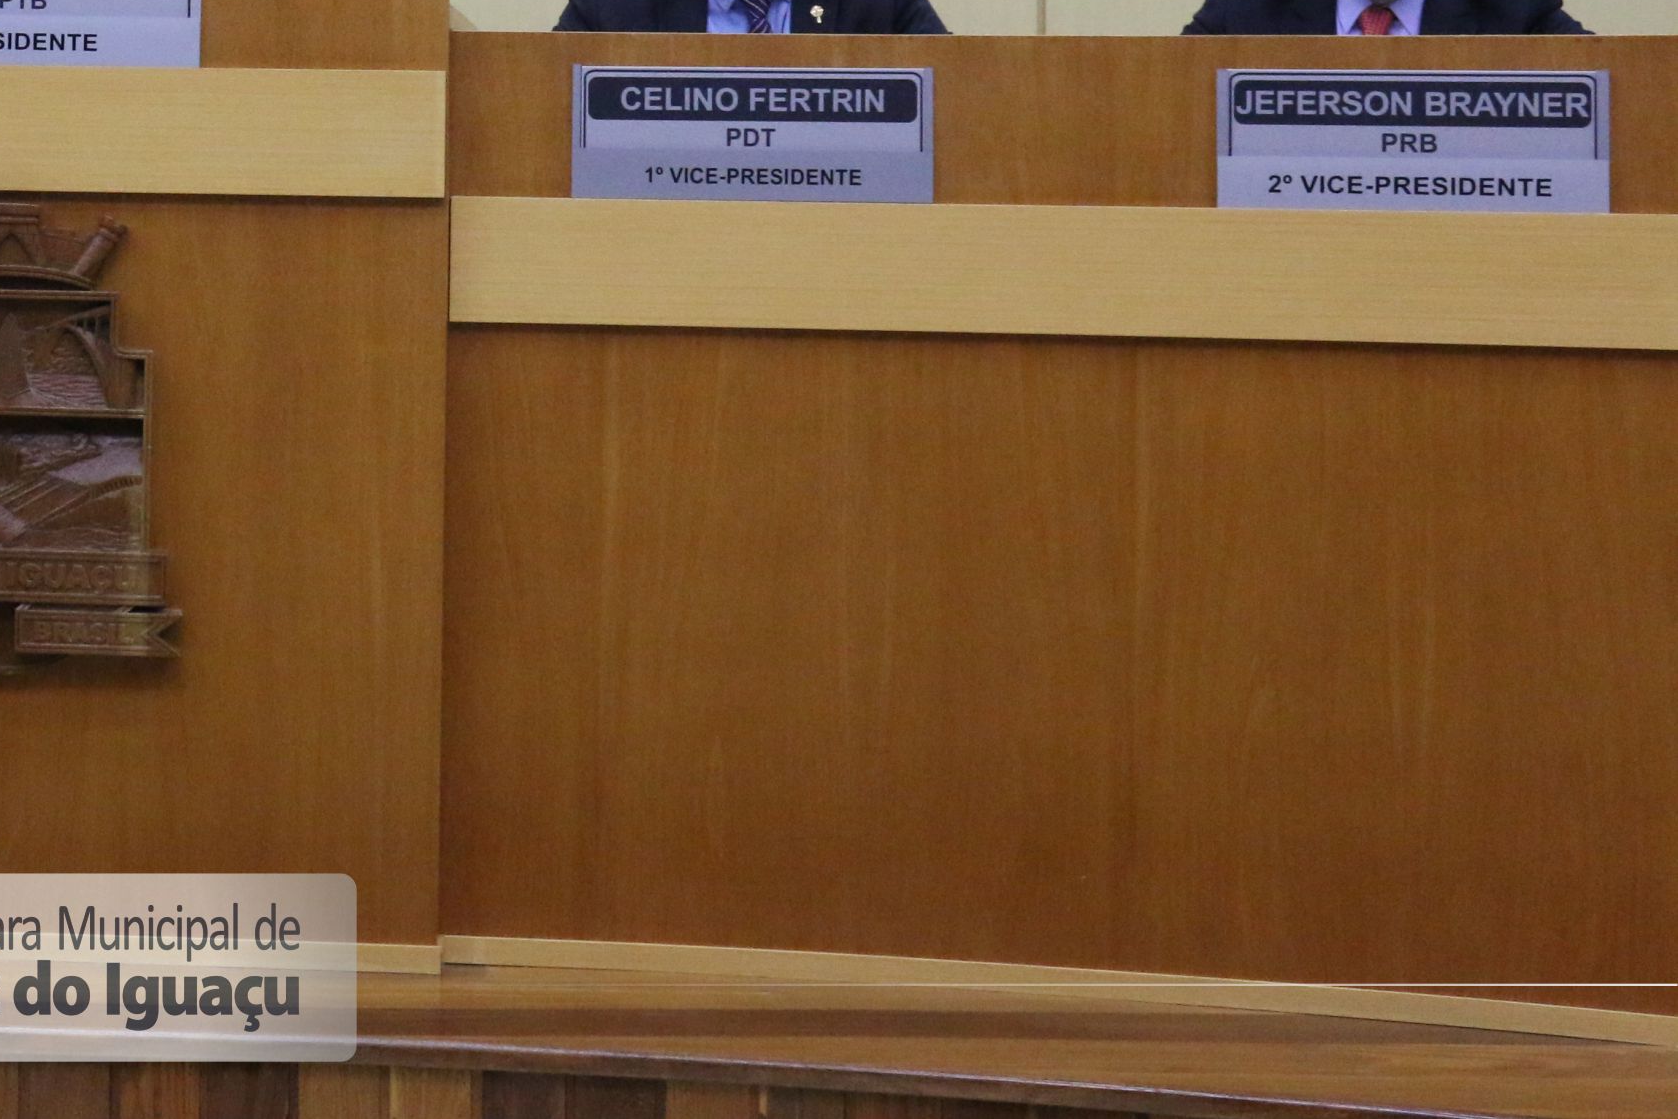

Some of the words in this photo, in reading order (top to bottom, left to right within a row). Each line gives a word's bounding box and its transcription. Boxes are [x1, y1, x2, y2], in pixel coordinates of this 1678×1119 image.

[620, 86, 739, 112] CELINO
[749, 87, 885, 113] FERTRIN
[1235, 90, 1413, 117] JEFERSON
[1425, 91, 1589, 118] BRAYNER
[725, 128, 777, 147] PDT
[1380, 133, 1438, 153] PRB
[644, 166, 664, 184] 1º
[669, 167, 863, 186] VICE-PRESIDENTE
[1268, 174, 1293, 194] 2º
[1300, 175, 1553, 198] VICE-PRESIDENTE
[36, 620, 137, 644] BRASIL
